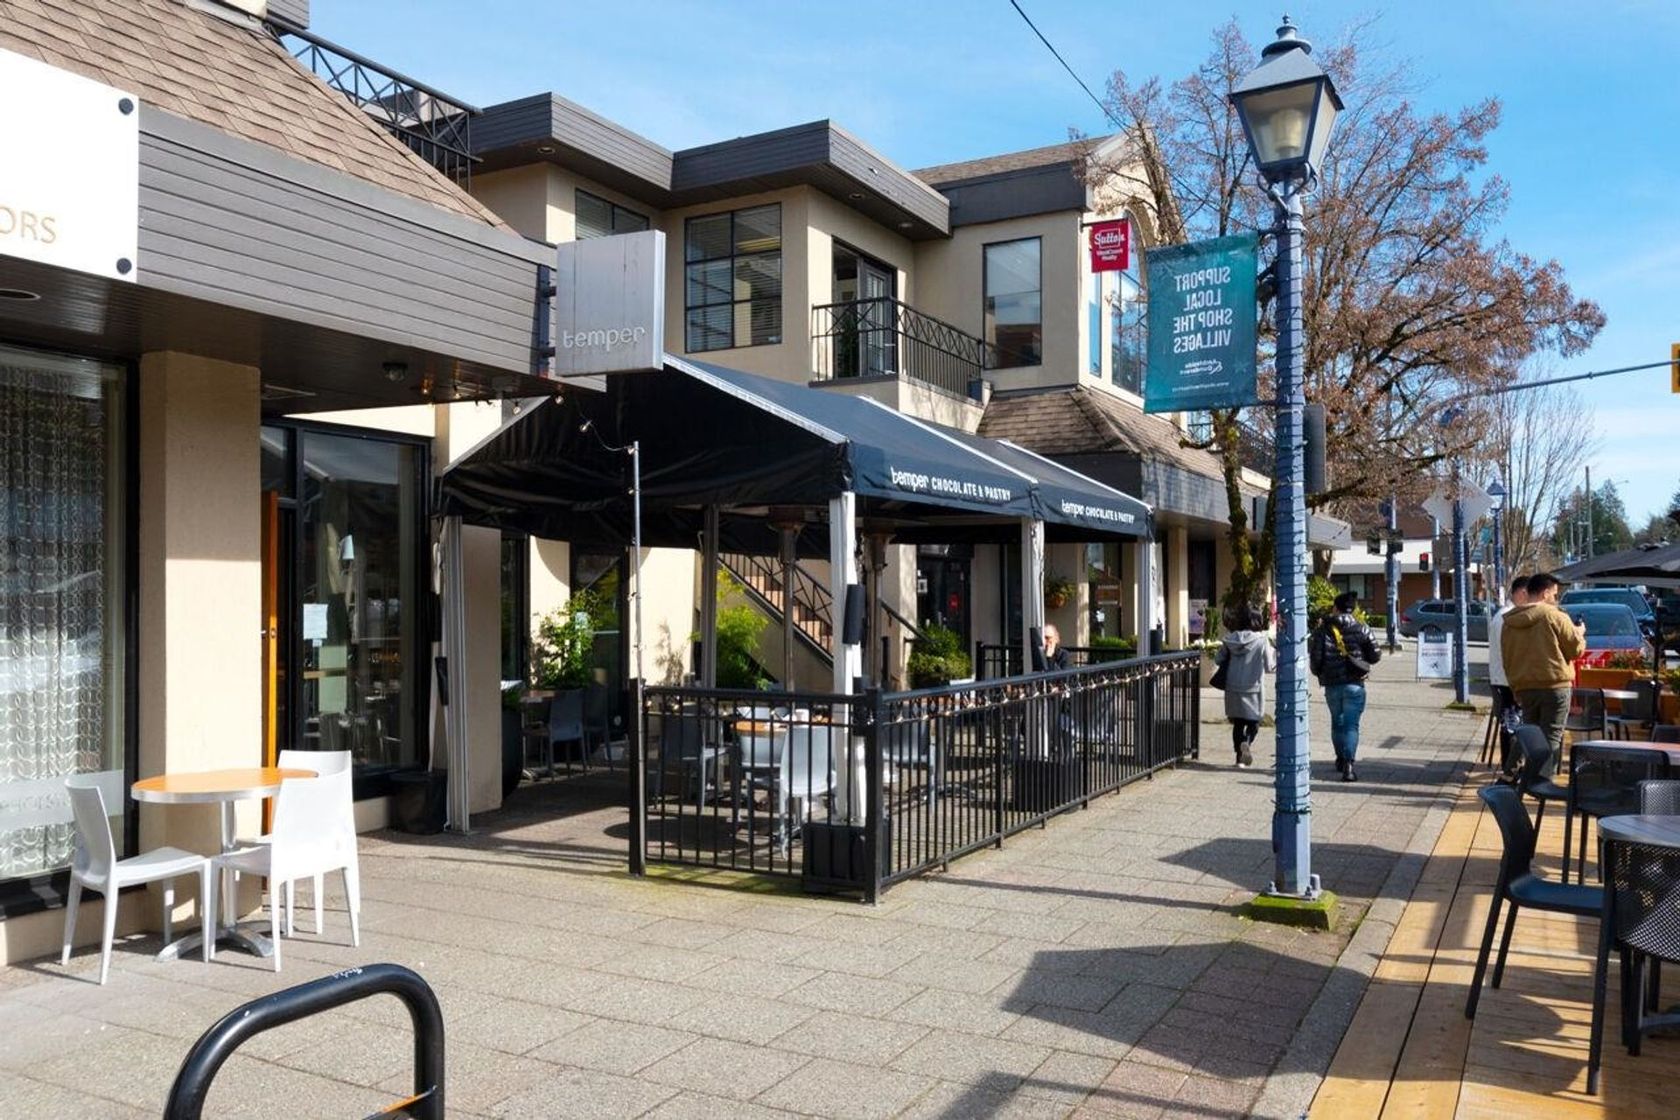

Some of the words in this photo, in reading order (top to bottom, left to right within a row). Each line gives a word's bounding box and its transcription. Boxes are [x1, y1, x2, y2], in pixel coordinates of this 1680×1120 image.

[563, 326, 645, 351] temper
[890, 466, 929, 492] temper
[931, 477, 977, 497] CHOCOLATE
[984, 486, 1011, 501] PASTRY
[1061, 498, 1084, 518] temper
[1085, 506, 1114, 521] CHOCOLATE
